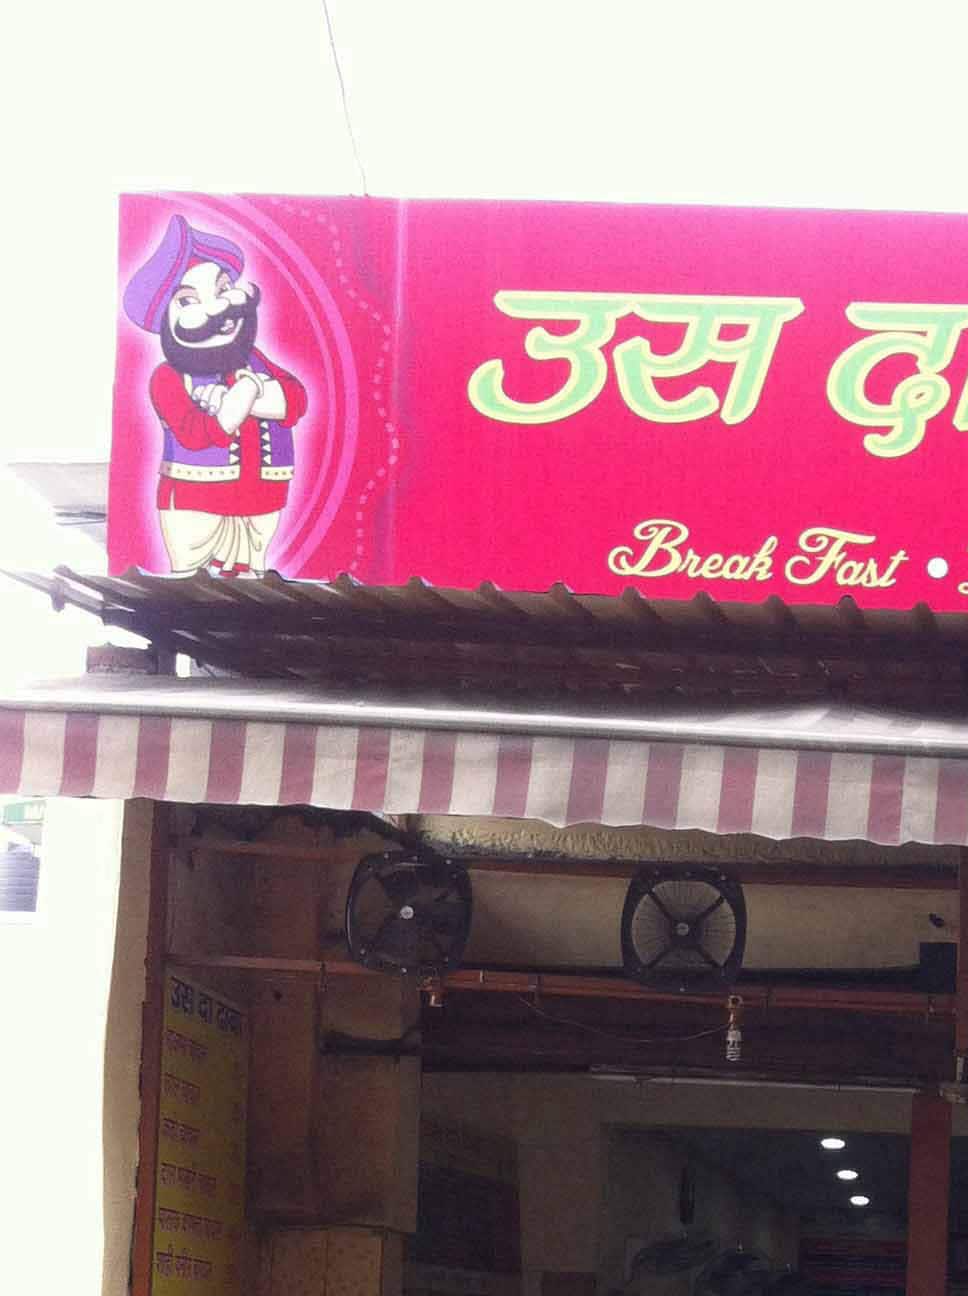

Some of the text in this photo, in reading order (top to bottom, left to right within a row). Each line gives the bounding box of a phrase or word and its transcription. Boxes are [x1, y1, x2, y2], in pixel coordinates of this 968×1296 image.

[467, 289, 806, 425] उस
[607, 519, 778, 582] Break
[784, 527, 909, 587] Fast
